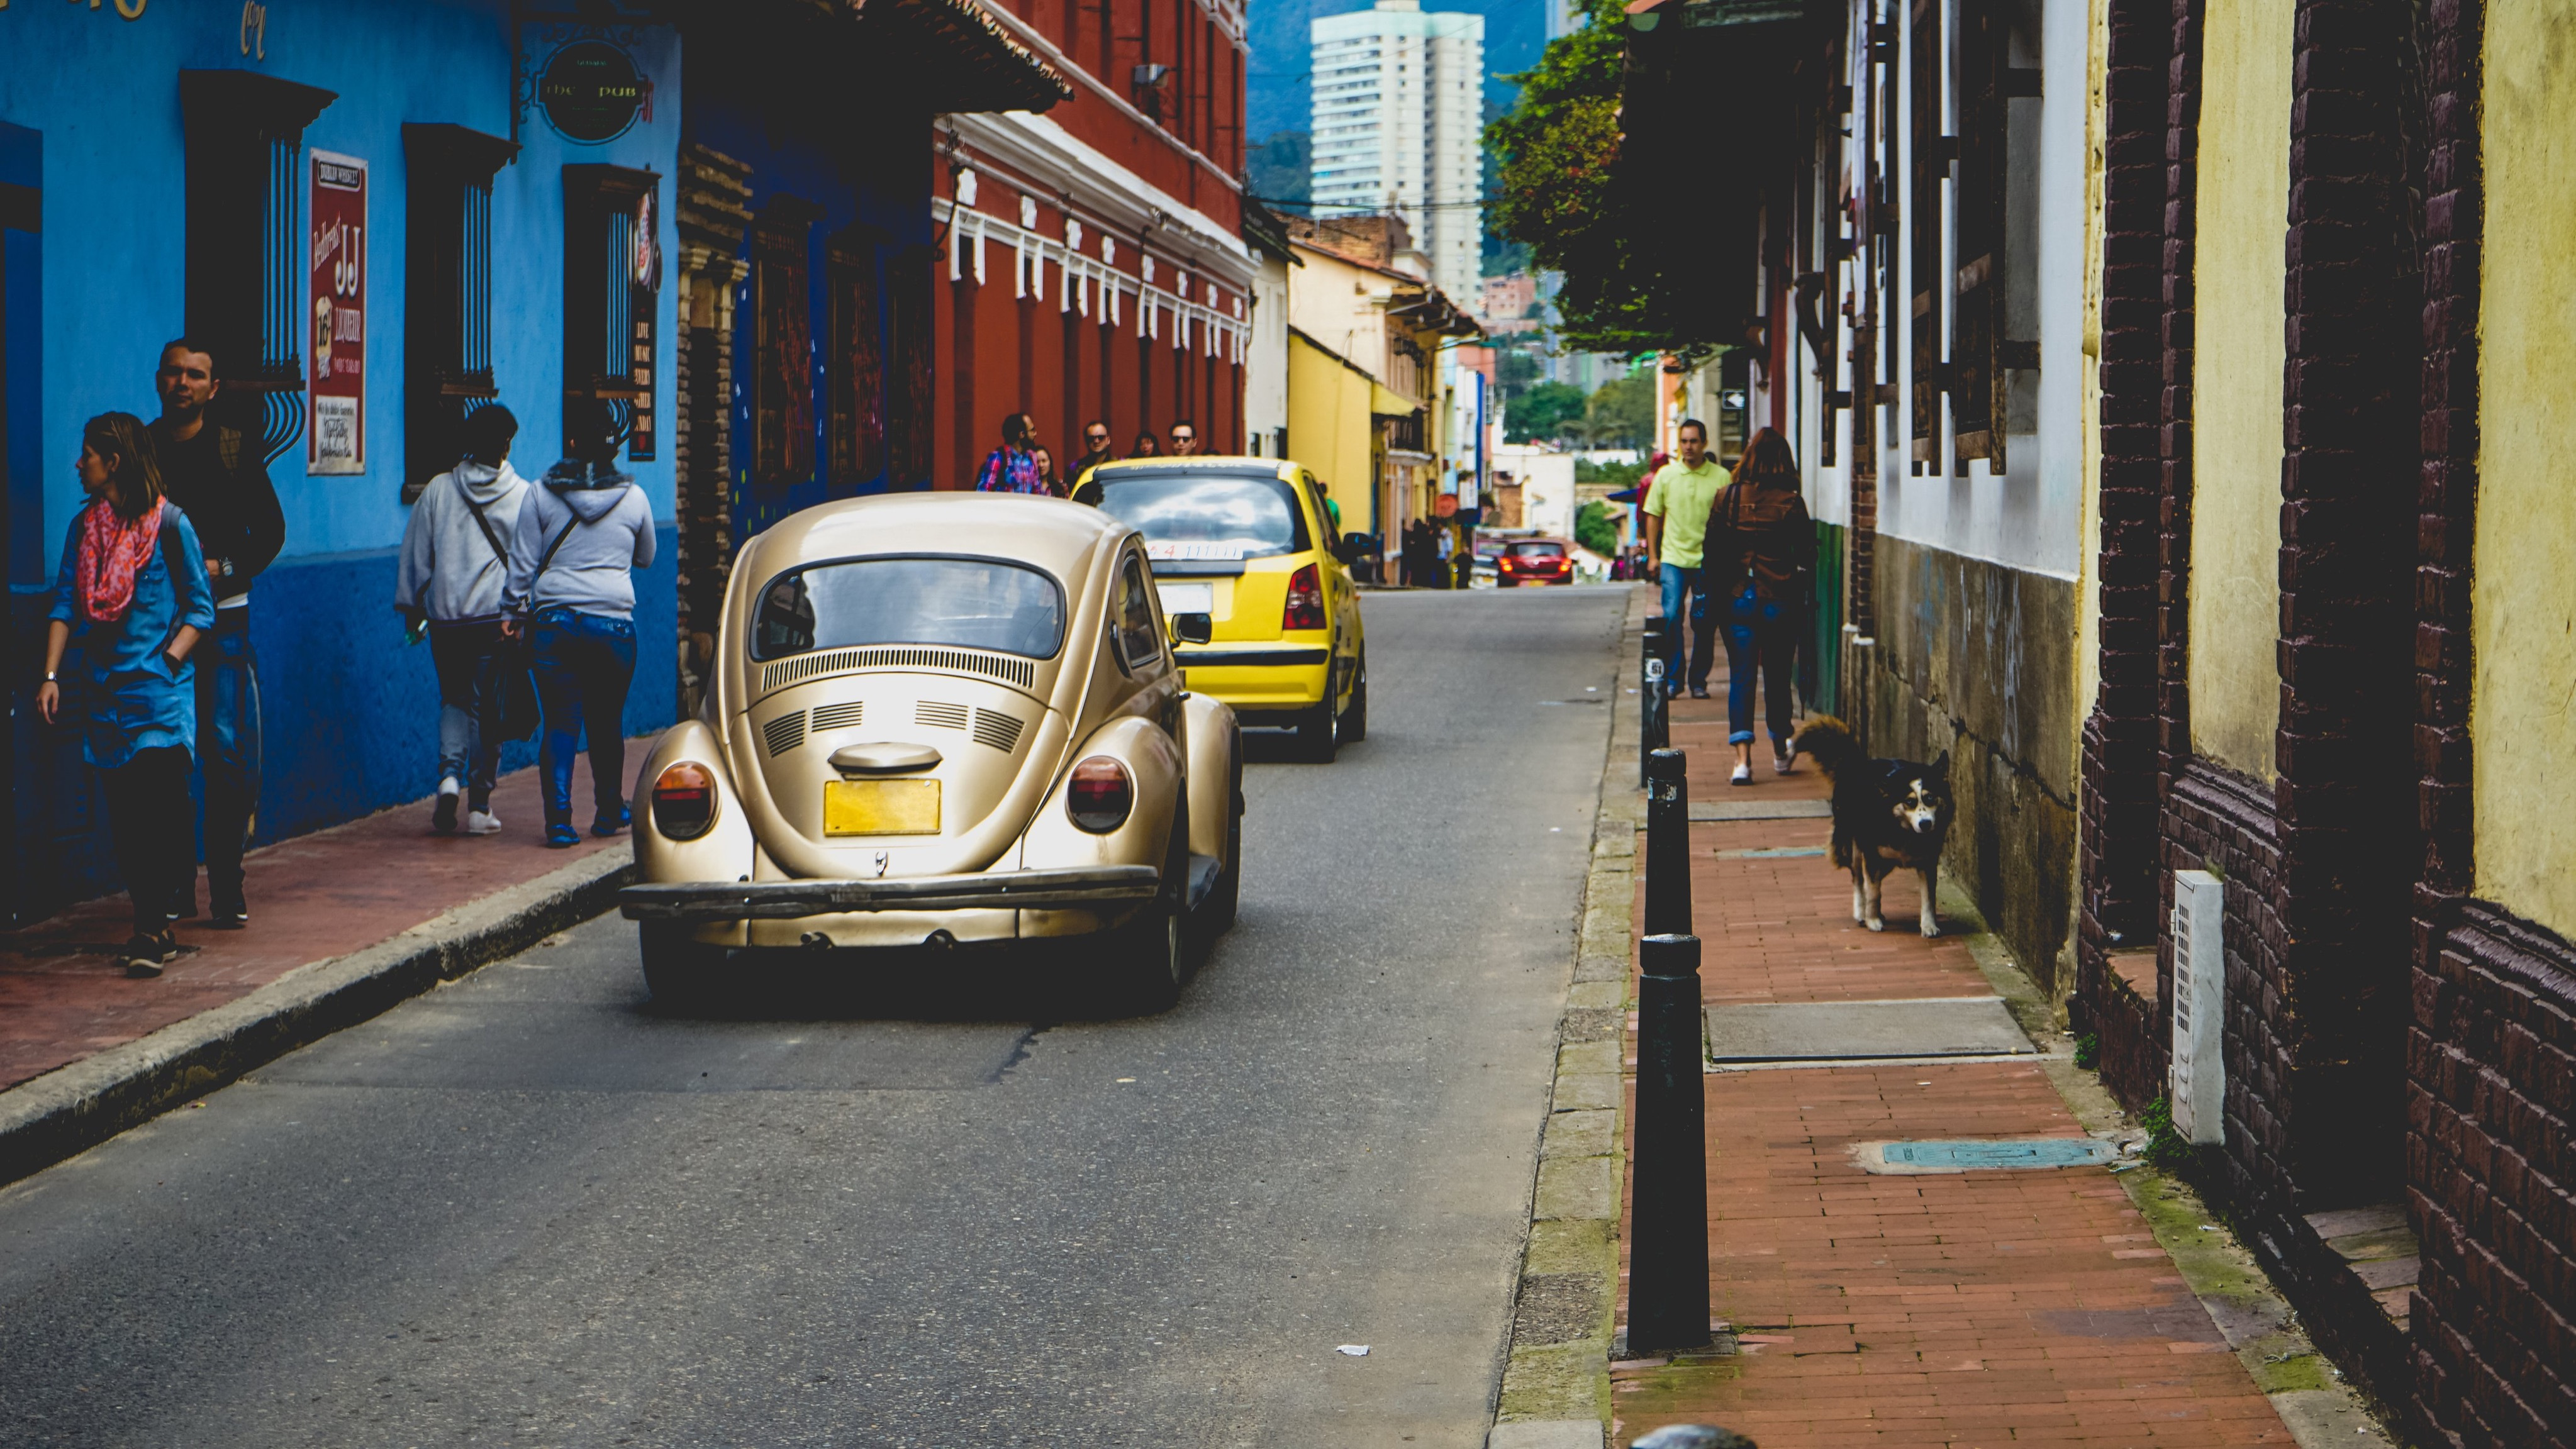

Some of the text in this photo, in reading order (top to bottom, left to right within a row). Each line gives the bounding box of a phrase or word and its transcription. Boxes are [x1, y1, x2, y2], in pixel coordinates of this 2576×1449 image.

[314, 210, 340, 272] Redbreast
[335, 224, 361, 297] JJ
[335, 306, 361, 343] LIQUEUR
[635, 321, 649, 339] LIVE
[634, 344, 650, 362] MUSIC
